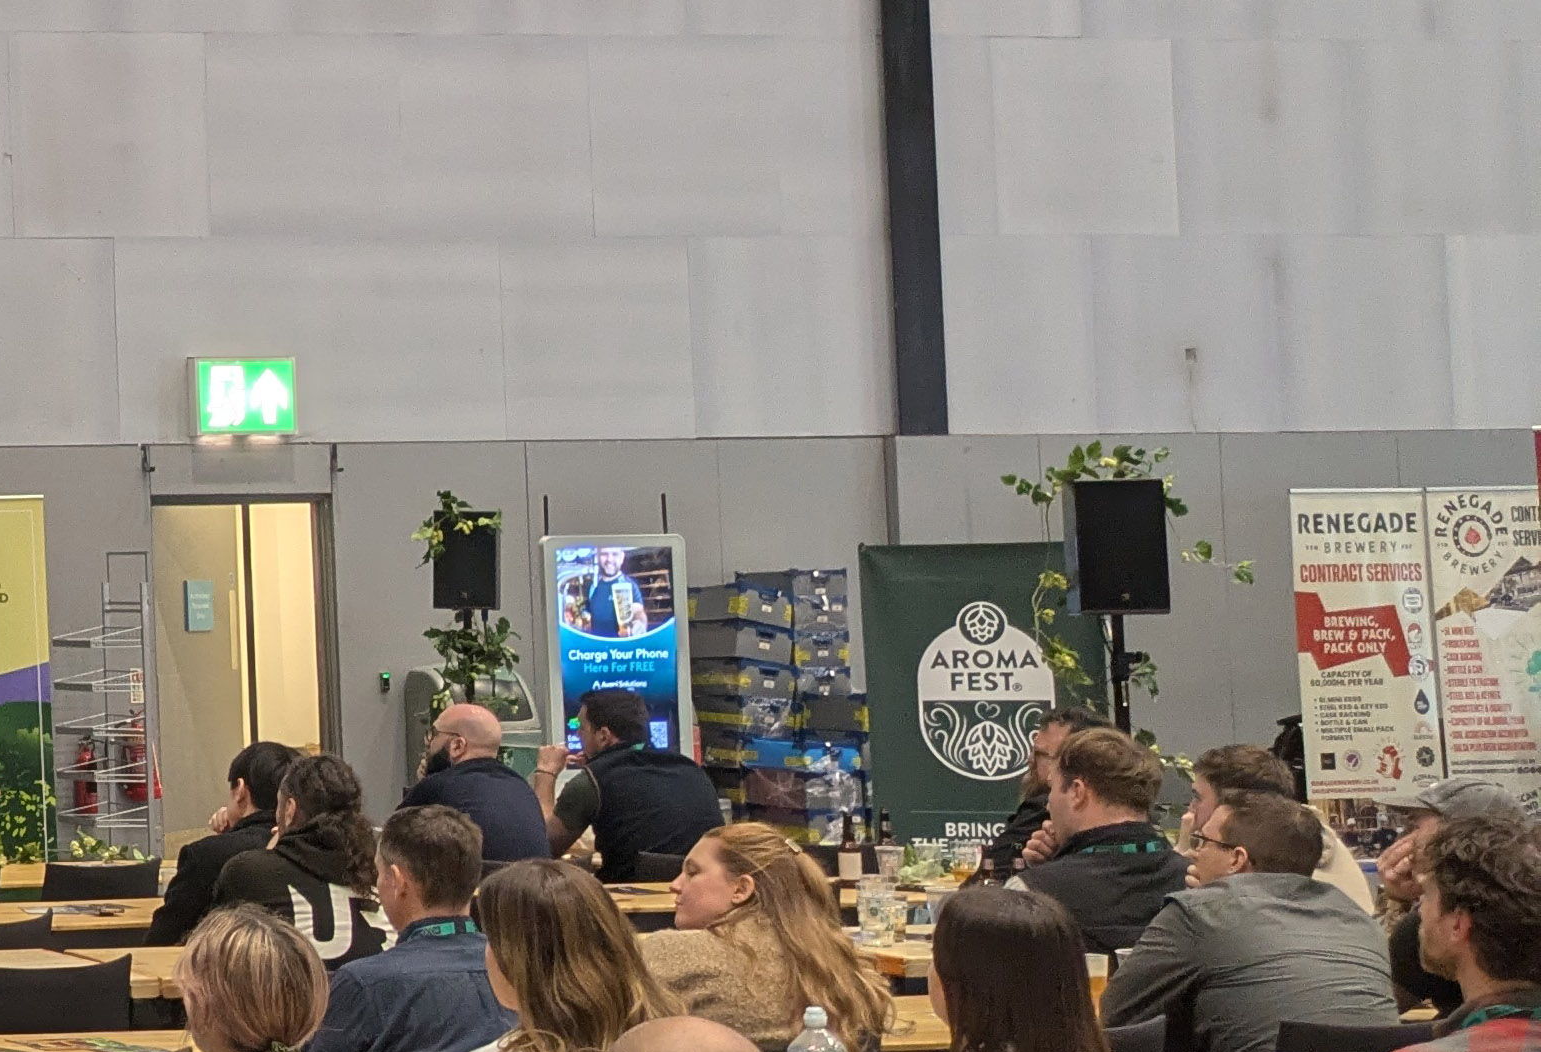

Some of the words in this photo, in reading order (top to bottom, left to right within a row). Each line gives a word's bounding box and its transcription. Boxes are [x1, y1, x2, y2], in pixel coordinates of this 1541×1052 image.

[1435, 494, 1509, 538] RENEGADE
[1511, 506, 1537, 522] CONT
[1297, 512, 1417, 534] RENEGADE
[1323, 540, 1397, 554] BREWERY
[1443, 550, 1503, 576] BREWERY
[1299, 564, 1363, 582] CONTRACT
[1366, 562, 1423, 582] SERVICES
[1323, 616, 1379, 628] BREWING,
[1313, 629, 1345, 642] BREW
[1349, 630, 1358, 640] &
[1361, 628, 1396, 642] PACK,
[568, 650, 608, 664] Charge
[609, 648, 633, 660] Your
[635, 648, 669, 659] Phone
[1323, 642, 1354, 654] PACK
[1357, 642, 1387, 654] ONLY
[583, 664, 609, 673] Here
[611, 663, 627, 672] For
[629, 662, 655, 672] FREE
[931, 650, 1039, 669] AROMA
[1321, 670, 1360, 678] CAPACITY
[1361, 670, 1372, 678] OF
[1348, 678, 1363, 686] PER
[1363, 678, 1384, 686] YEAR
[945, 822, 1006, 838] BRING
